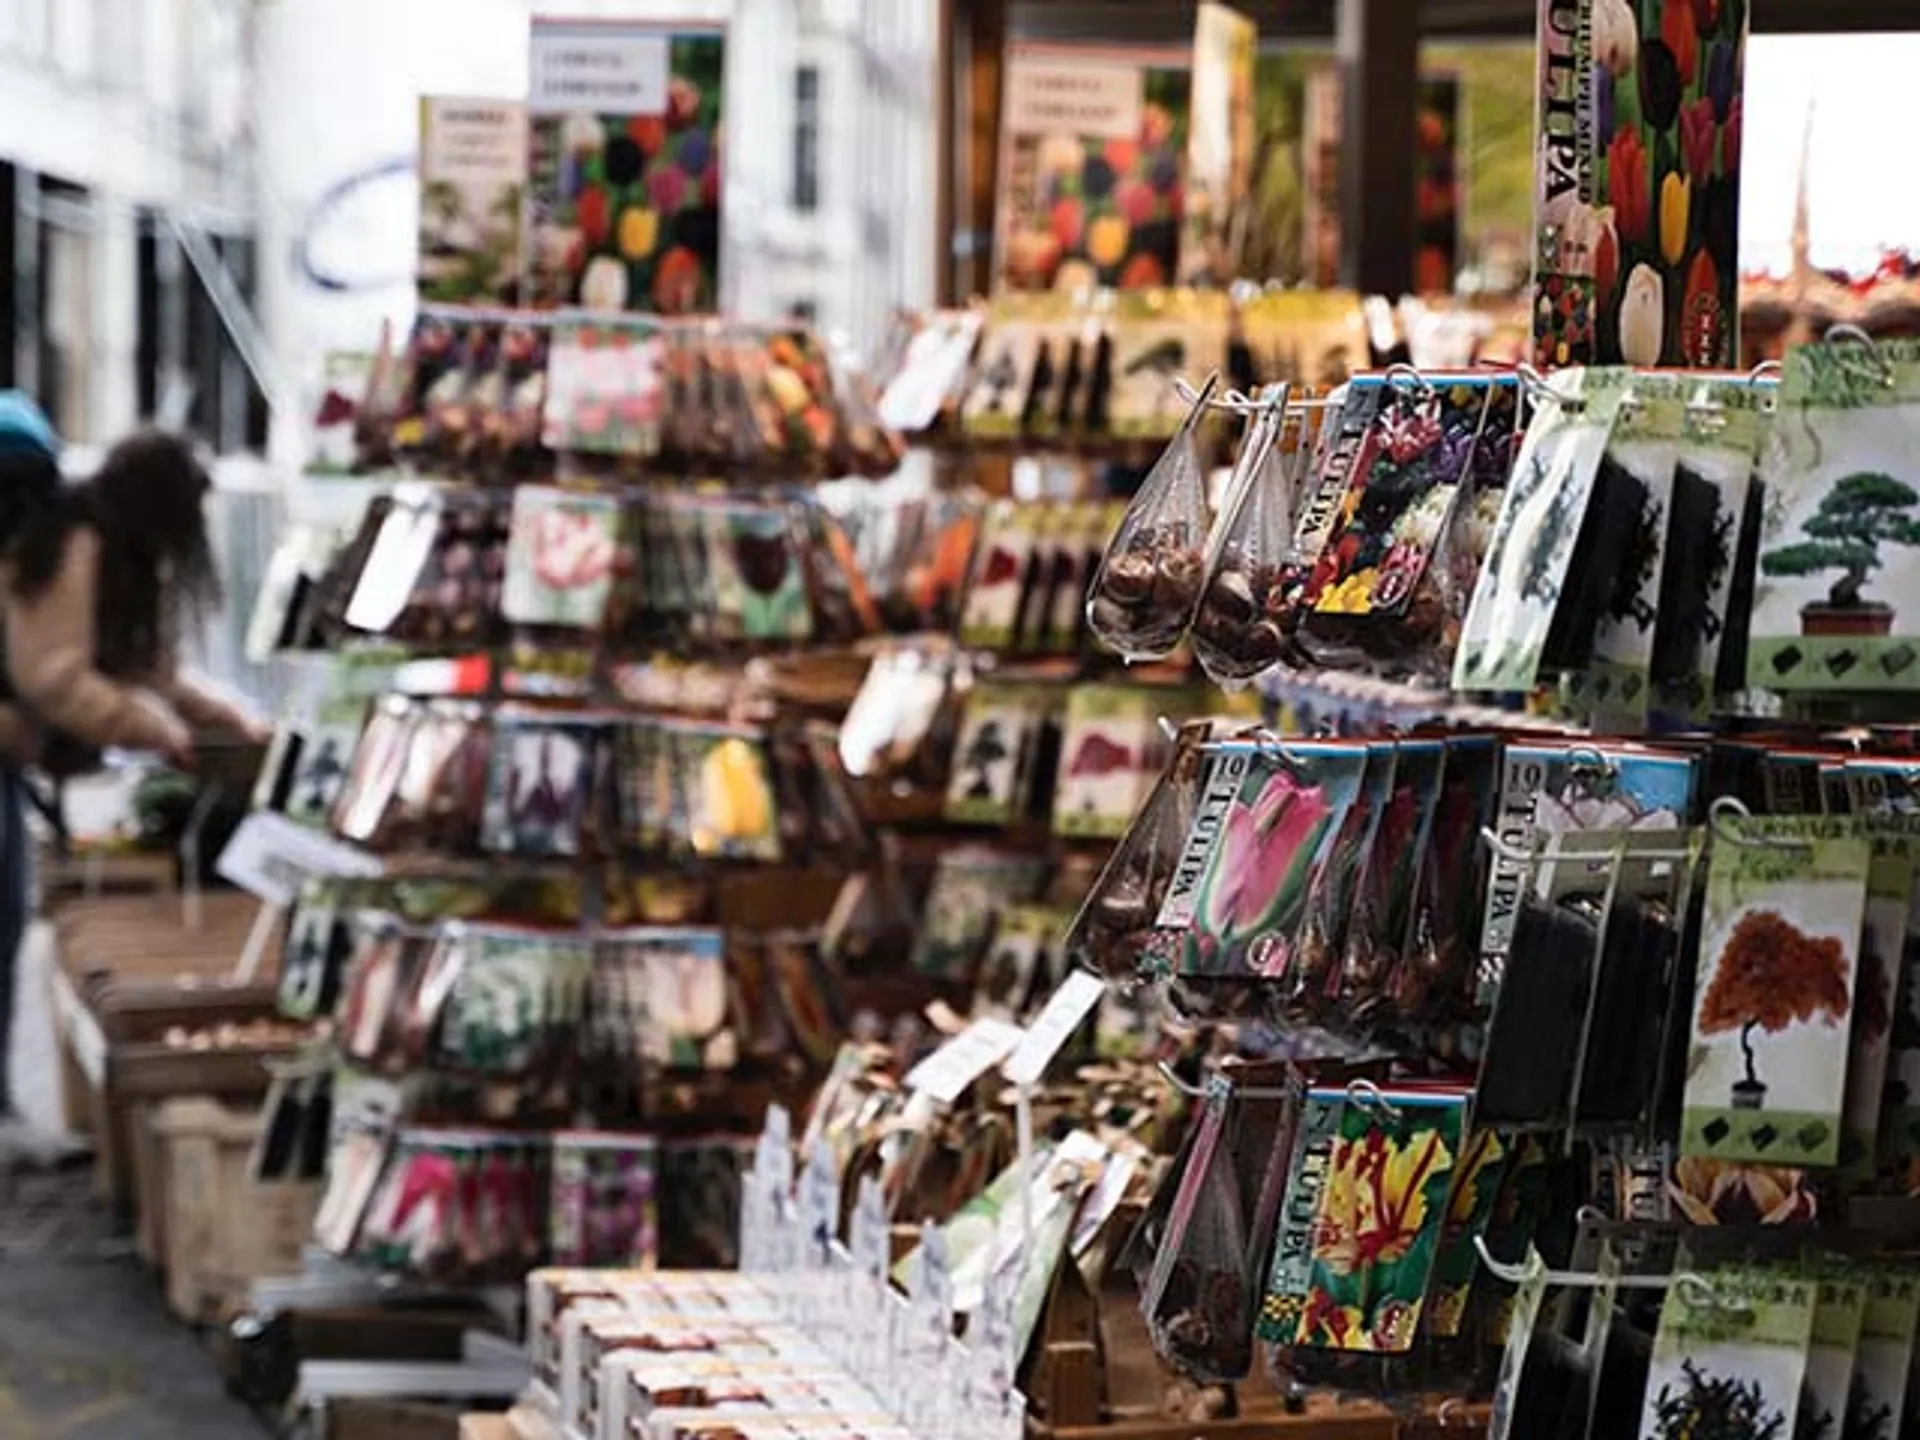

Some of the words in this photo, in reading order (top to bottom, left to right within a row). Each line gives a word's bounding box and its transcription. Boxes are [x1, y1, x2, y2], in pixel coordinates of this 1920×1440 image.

[1578, 0, 1593, 111] RIUMPH
[1302, 428, 1363, 536] TULIPA
[1171, 783, 1236, 897] TULIPA
[1282, 1138, 1334, 1260] TULIPA
